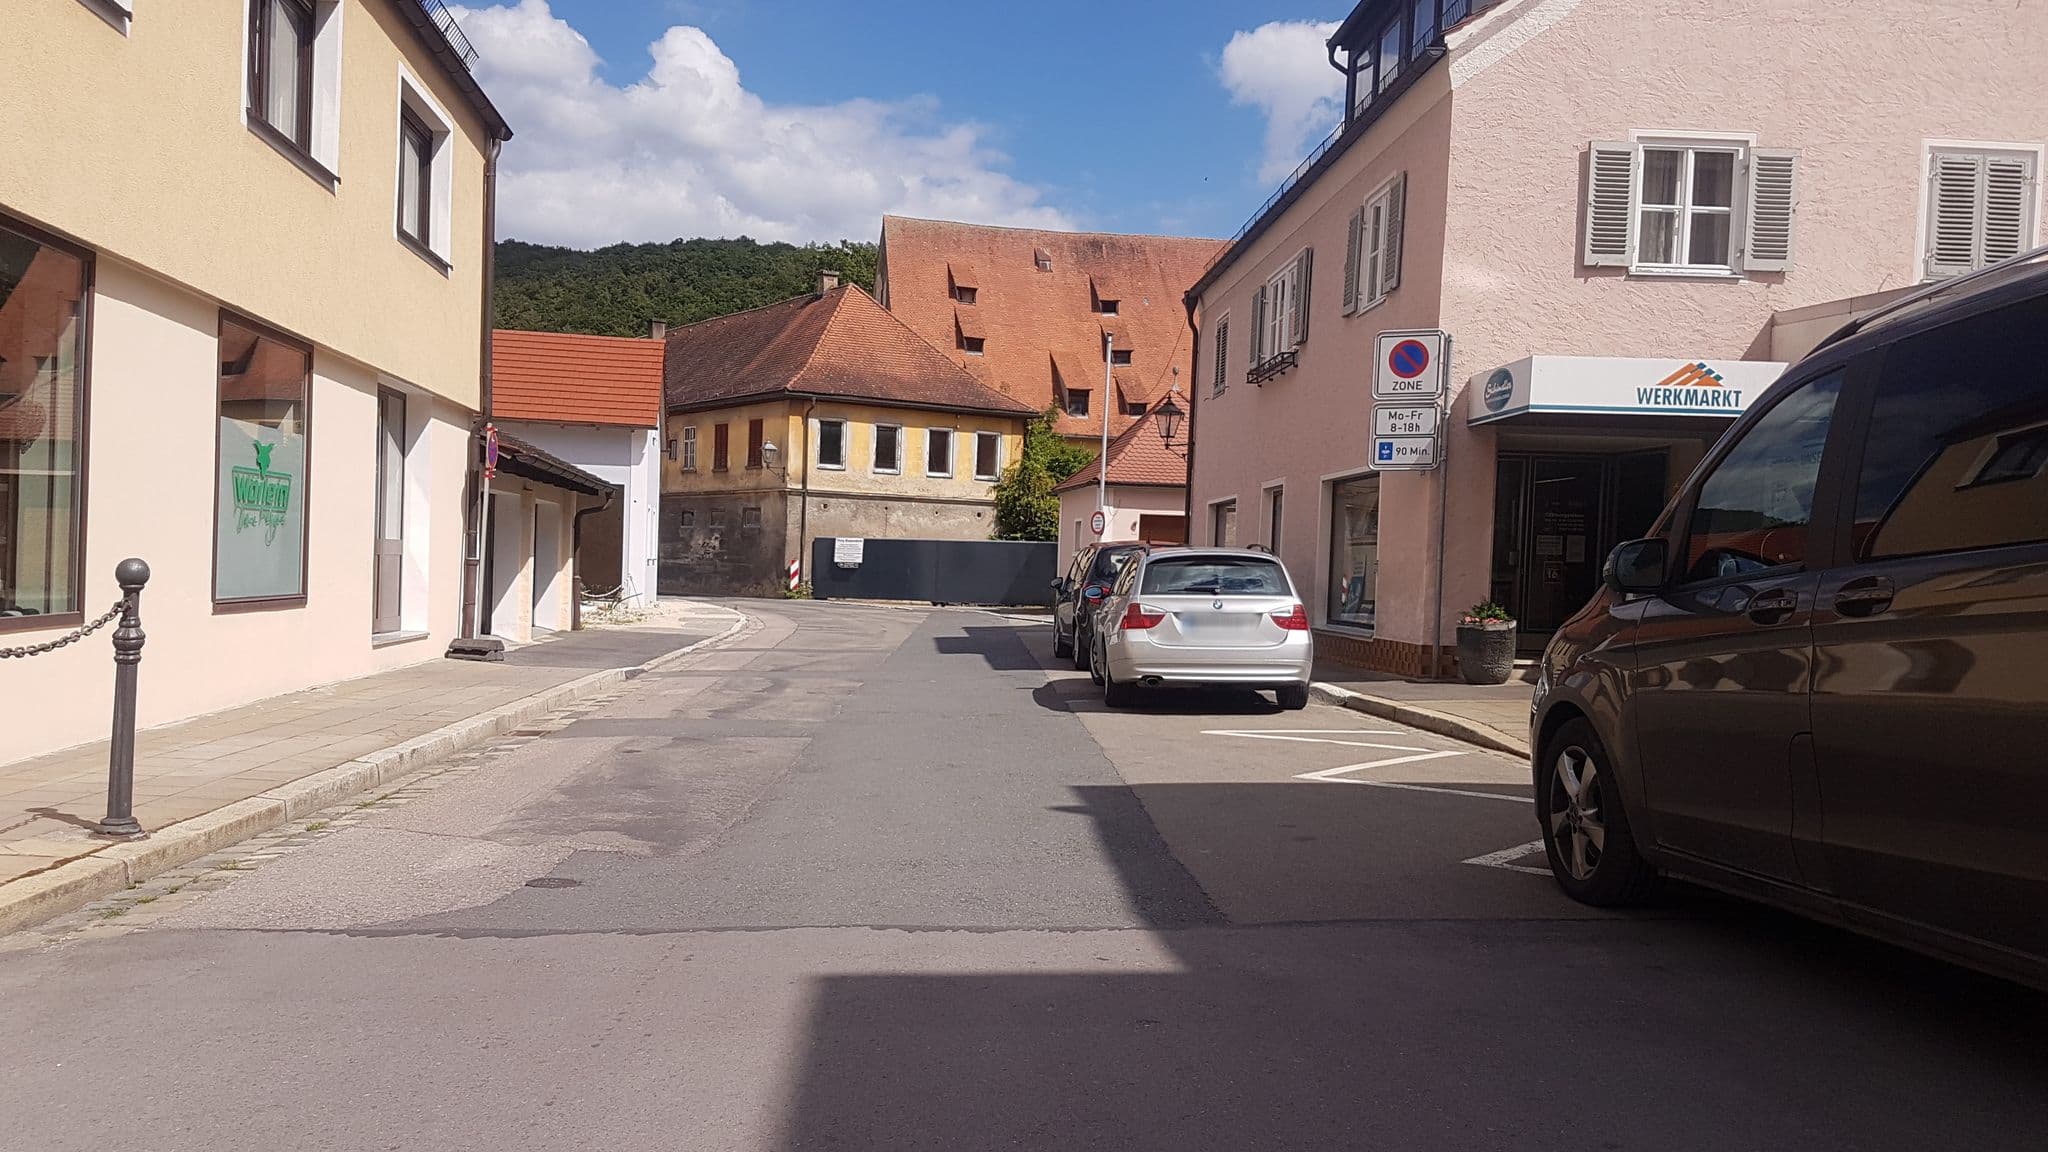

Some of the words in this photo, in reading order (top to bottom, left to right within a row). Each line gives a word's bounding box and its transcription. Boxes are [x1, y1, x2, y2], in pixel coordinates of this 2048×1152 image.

[1392, 380, 1424, 391] ZONE
[1637, 387, 1742, 407] WERKMARKT
[1388, 411, 1423, 421] Mo-Fr
[1390, 423, 1420, 433] 8-18h
[1395, 446, 1407, 456] 90
[1410, 446, 1430, 456] Min.
